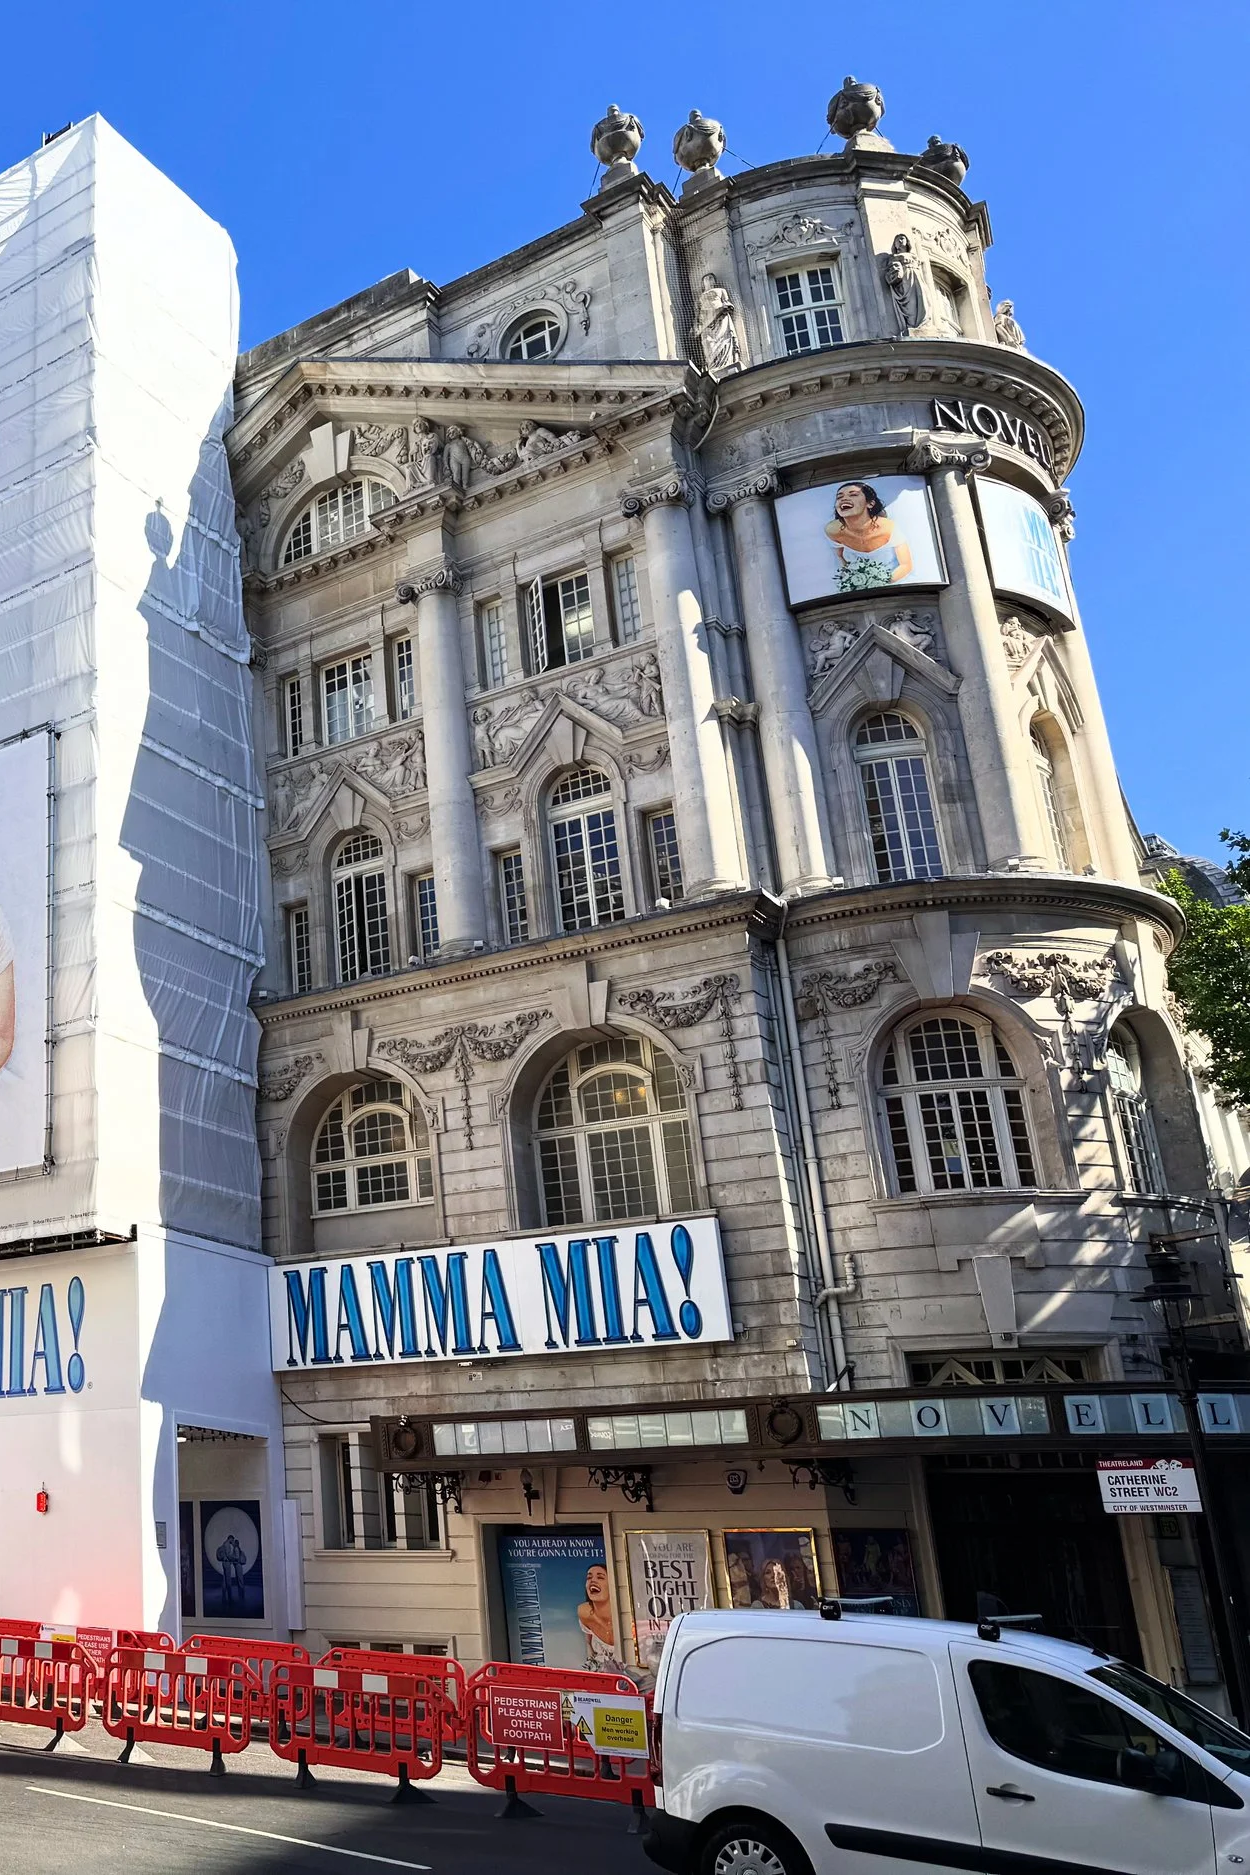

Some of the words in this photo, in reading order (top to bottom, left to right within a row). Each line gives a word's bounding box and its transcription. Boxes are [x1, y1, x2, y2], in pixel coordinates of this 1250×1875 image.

[283, 1248, 524, 1366] MAMMA
[535, 1224, 703, 1349] MIA!
[1098, 1460, 1144, 1468] THEATRELAND
[1107, 1474, 1168, 1486] CATHERINE
[1110, 1487, 1150, 1497] STREET
[1153, 1486, 1179, 1497] WC2
[513, 1539, 530, 1548] YOU
[531, 1539, 568, 1548] ALREADY
[569, 1540, 595, 1548] KNOW
[652, 1543, 673, 1552] YOU
[677, 1543, 695, 1552] ARE
[508, 1549, 537, 1557] YOU'RE
[537, 1549, 567, 1557] GONNA
[568, 1549, 589, 1558] LOVE
[591, 1549, 604, 1558] IT!
[643, 1560, 695, 1579] BEST
[645, 1581, 698, 1596] NIGHT
[648, 1596, 699, 1618] OUT
[649, 1619, 661, 1631] IN
[77, 1633, 111, 1643] PEDESTRIANS
[520, 1613, 545, 1667] AMMA
[494, 1696, 558, 1710] PEDESTRIANS
[498, 1707, 534, 1720] PLEASE
[536, 1711, 555, 1721] USE
[605, 1714, 633, 1724] Danger
[510, 1719, 543, 1731] OTHER
[503, 1729, 552, 1742] FOOTPATH
[601, 1726, 613, 1734] Men
[615, 1727, 639, 1737] working
[606, 1735, 635, 1743] overhead
